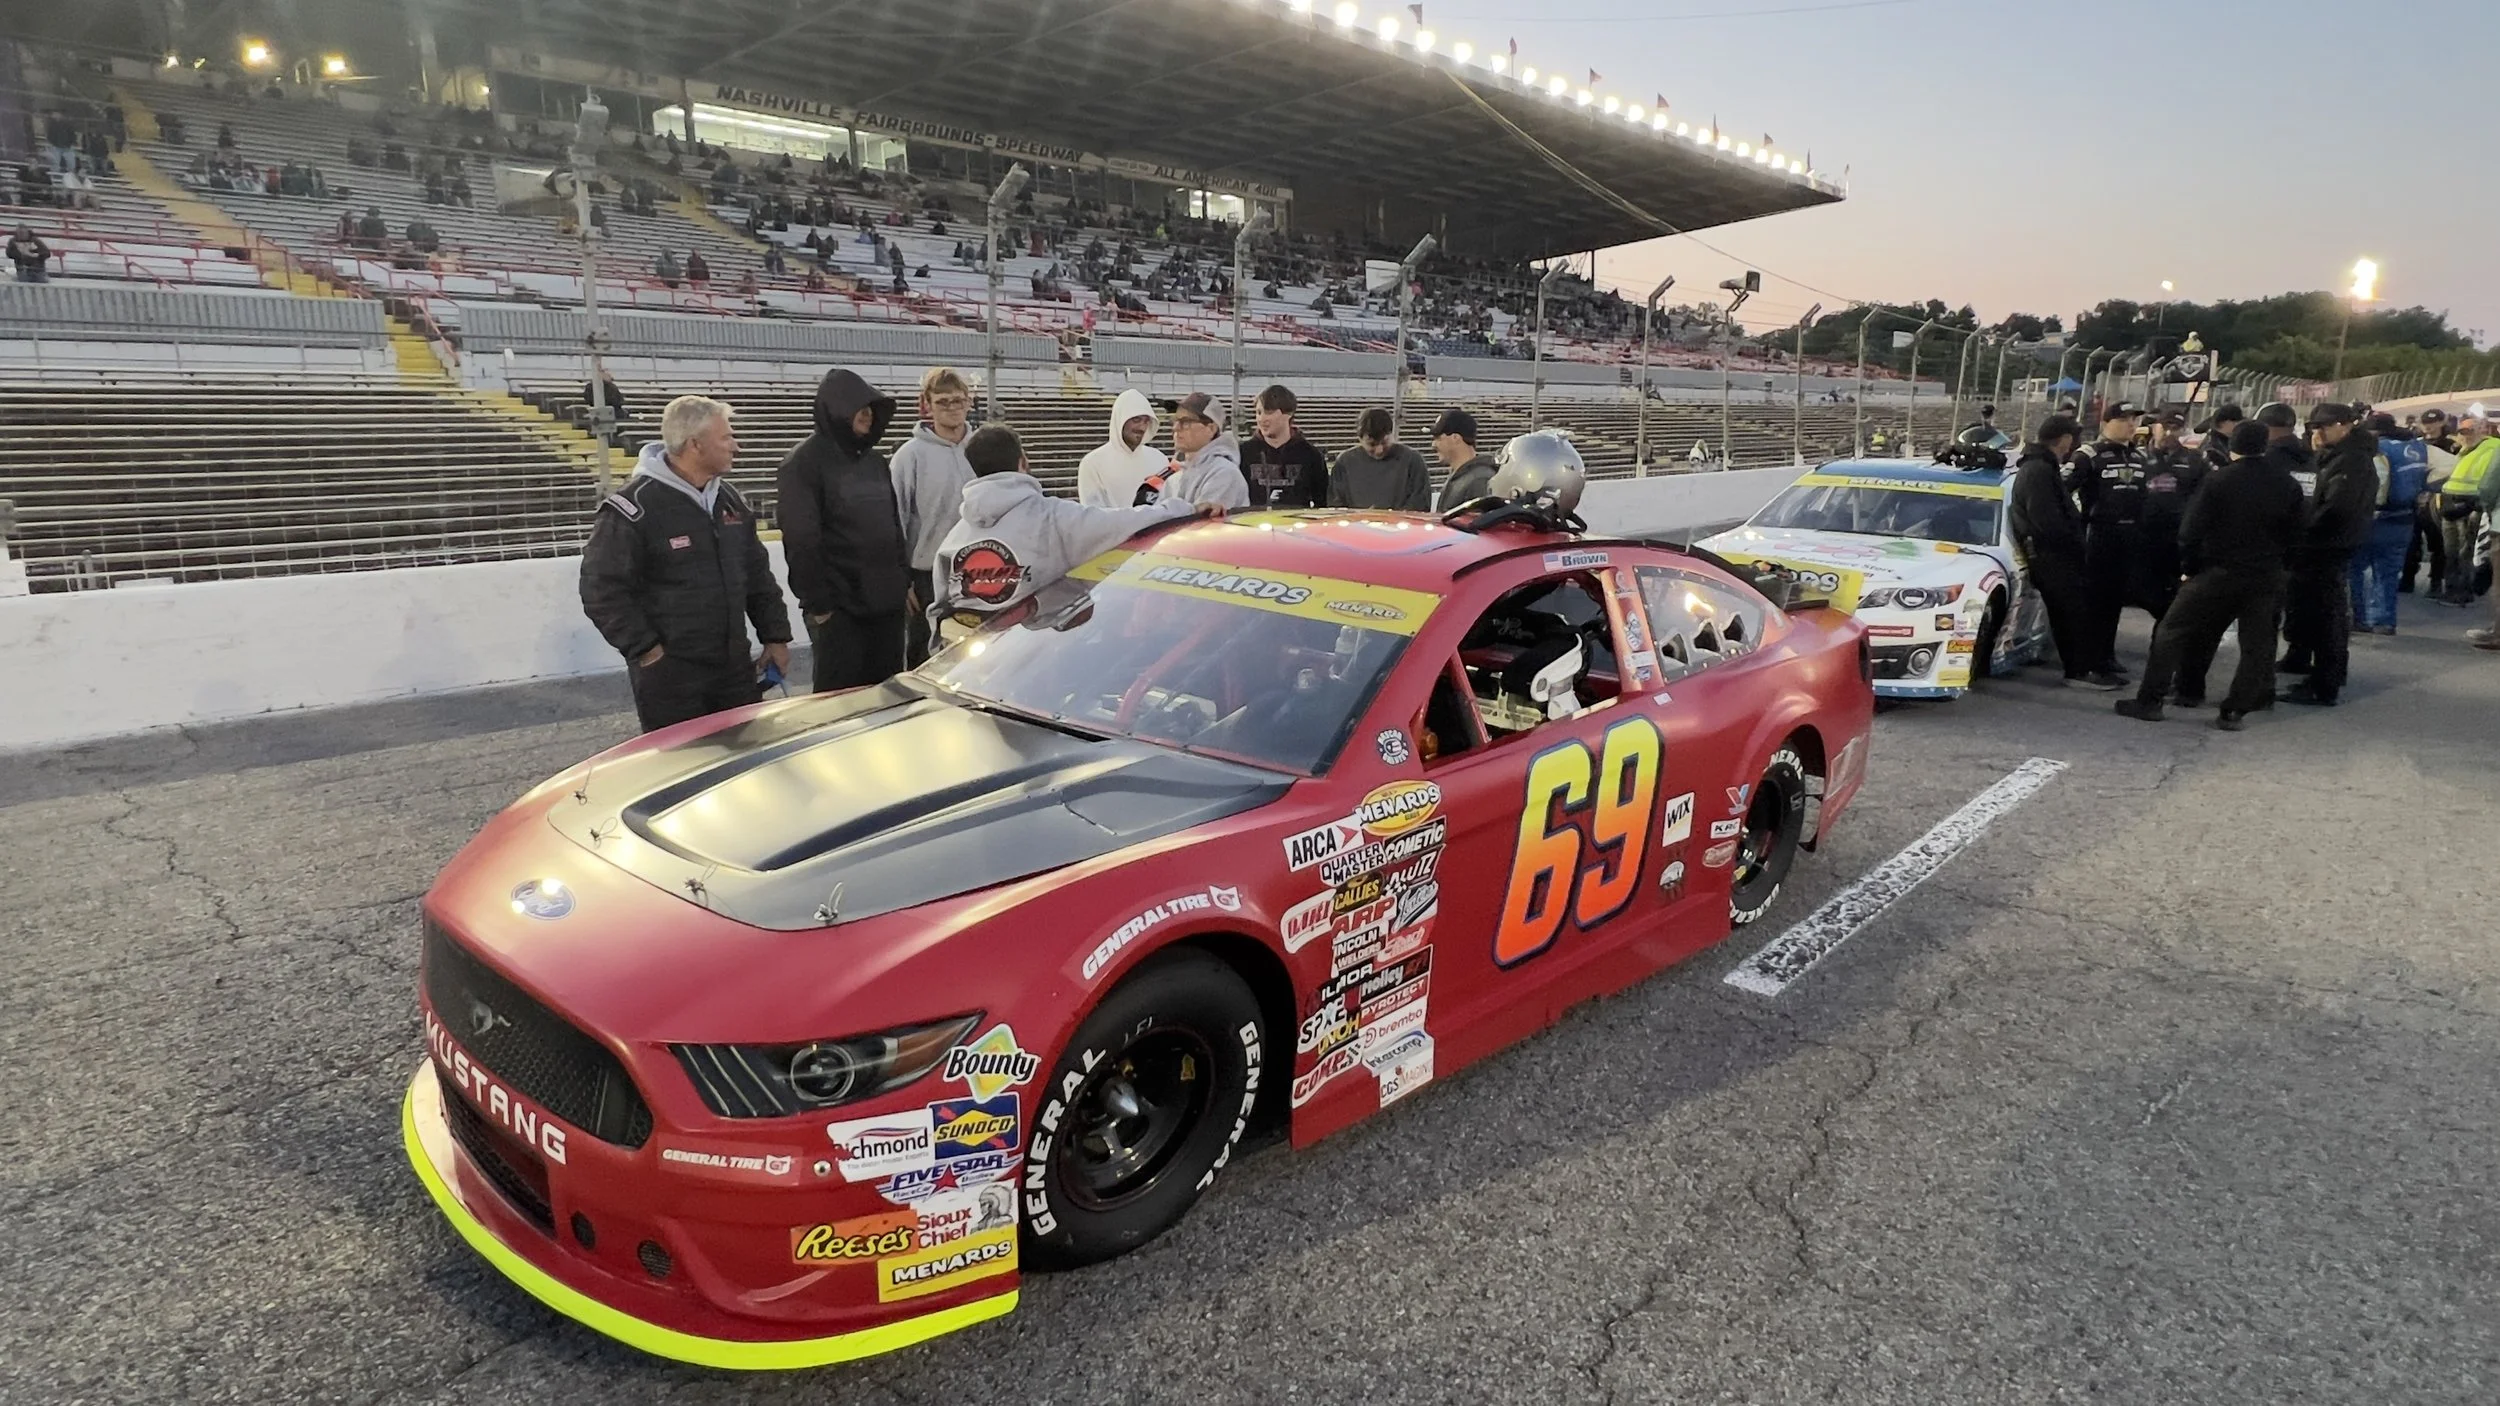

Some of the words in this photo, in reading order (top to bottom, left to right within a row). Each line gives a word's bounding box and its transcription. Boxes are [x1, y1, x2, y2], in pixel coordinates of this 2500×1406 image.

[717, 85, 841, 120] NASHVILLE
[1154, 166, 1177, 180] ALL
[1184, 170, 1249, 192] AMERICAN
[1254, 184, 1278, 197] 400
[1847, 478, 1943, 491] MENARDS
[1139, 564, 1312, 605] MENARDS
[1324, 601, 1408, 621] MENARDS
[1353, 785, 1441, 827] MENARDS
[1666, 796, 1691, 829] WIX
[1291, 827, 1338, 867] ARCA
[1385, 824, 1444, 865] COMETIC
[1492, 714, 1666, 969] 69
[1321, 843, 1381, 880] QUARTER
[1333, 854, 1386, 885] MASTER
[1334, 879, 1380, 911] CALLIES
[1332, 896, 1395, 936] ARP
[1083, 904, 1170, 980] GENERAL
[1166, 893, 1211, 915] TIRE
[1334, 928, 1378, 956] INCOLN
[1322, 963, 1373, 1001] ILMOR
[1360, 978, 1424, 1018] PYROTECT
[1361, 965, 1404, 997] Holley
[1379, 1008, 1423, 1038] brembo
[946, 1048, 1039, 1081] Bounty
[1293, 1050, 1347, 1100] COMP
[425, 1010, 567, 1166] MUSTANG
[1195, 1021, 1262, 1192] GENERAL
[936, 1117, 1012, 1142] SUNOCO
[1025, 1048, 1106, 1237] GENERAL
[662, 1149, 728, 1167] GENERAL
[729, 1156, 764, 1170] TIRE
[893, 1165, 945, 1191] FIVE
[951, 1154, 1004, 1171] STAR
[917, 1206, 972, 1231] Sioux
[917, 1223, 967, 1249] Chief
[892, 1240, 1012, 1285] MENARDS
